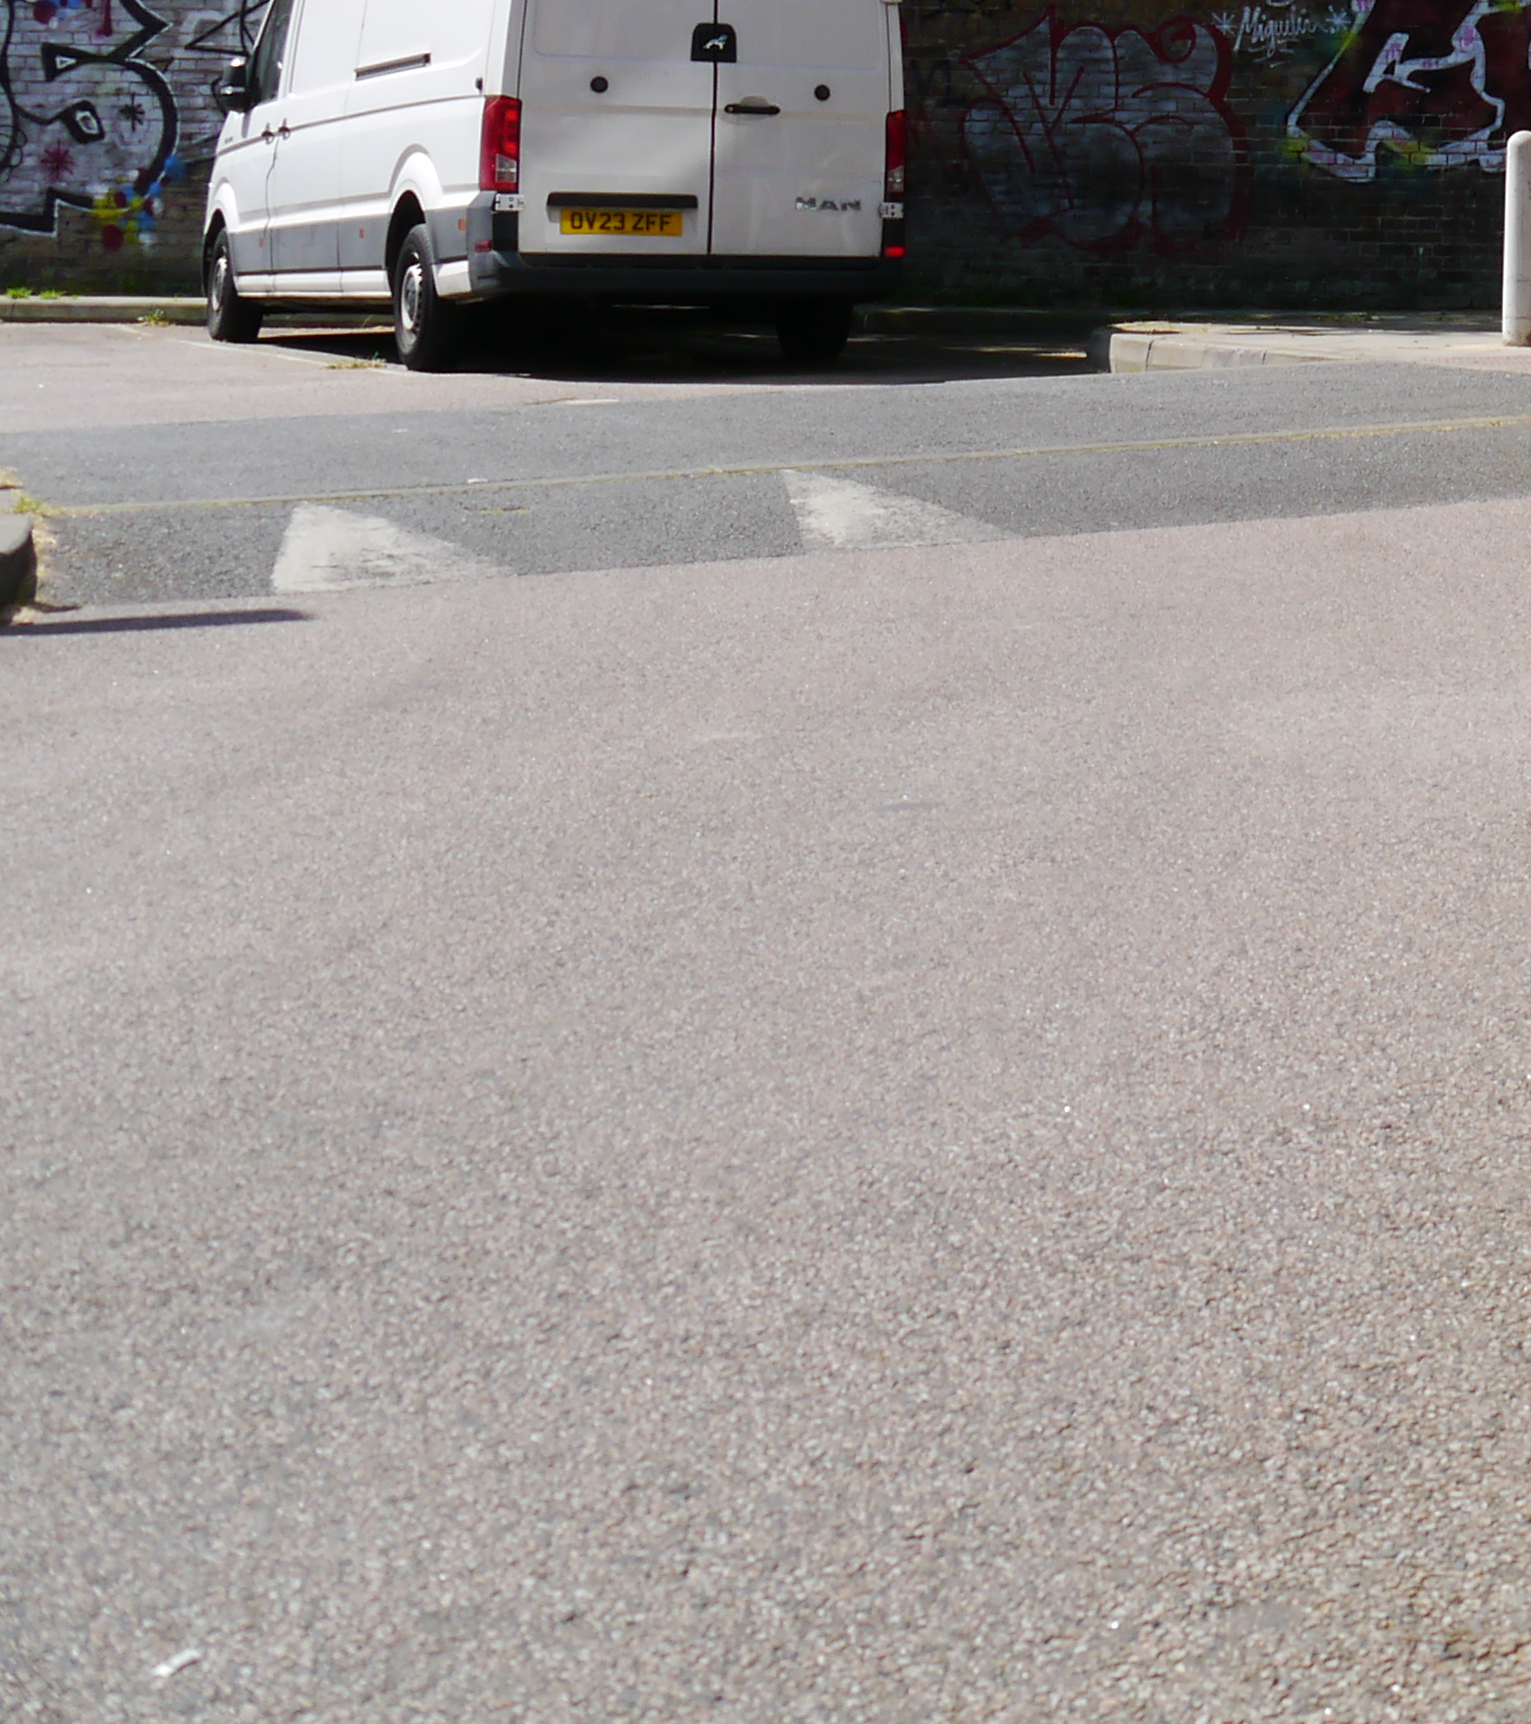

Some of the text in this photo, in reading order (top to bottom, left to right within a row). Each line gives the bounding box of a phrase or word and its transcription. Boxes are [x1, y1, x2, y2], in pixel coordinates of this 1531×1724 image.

[795, 196, 862, 212] MAN
[570, 210, 672, 233] OV23 ZFF
